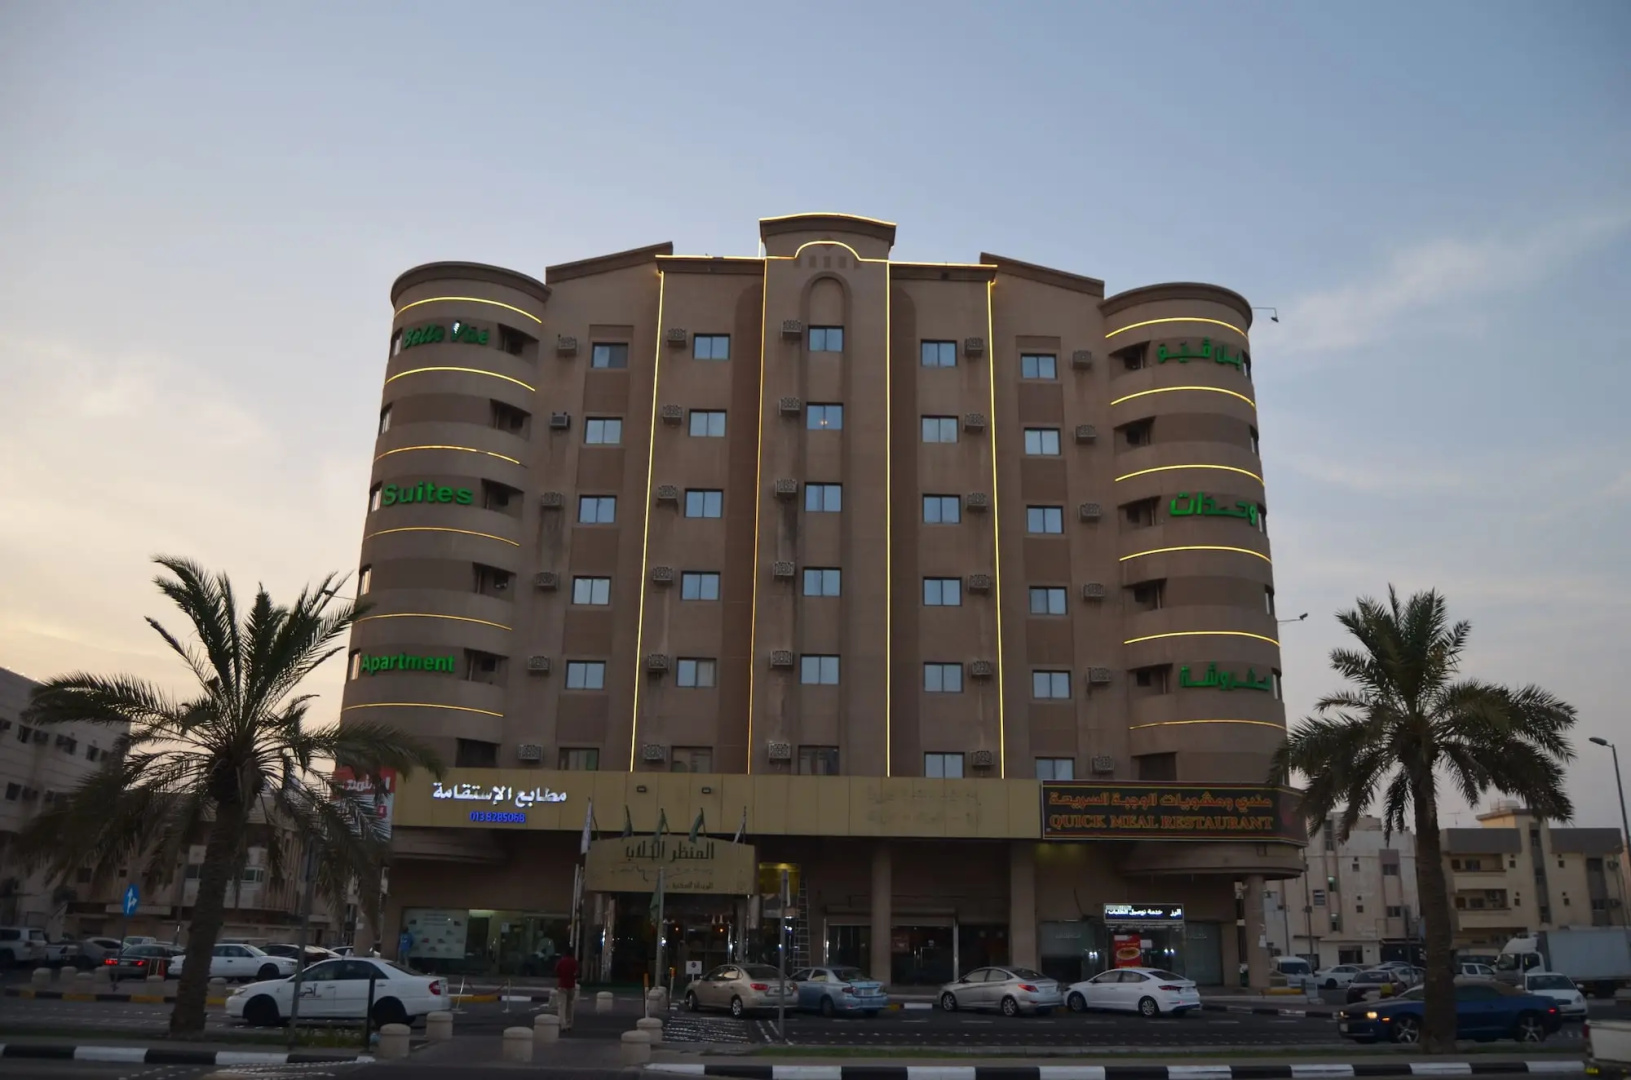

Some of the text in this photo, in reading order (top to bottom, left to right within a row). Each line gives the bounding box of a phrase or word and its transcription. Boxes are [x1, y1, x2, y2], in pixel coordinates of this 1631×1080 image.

[382, 480, 474, 506] Suites
[1169, 491, 1257, 526] وحدات
[360, 651, 456, 676] Apartment
[1049, 791, 1109, 810] السريعة
[1111, 792, 1158, 810] الوجبة
[1049, 814, 1274, 830] QUICK MEAL RESTAURANT
[670, 841, 715, 863] المنظر
